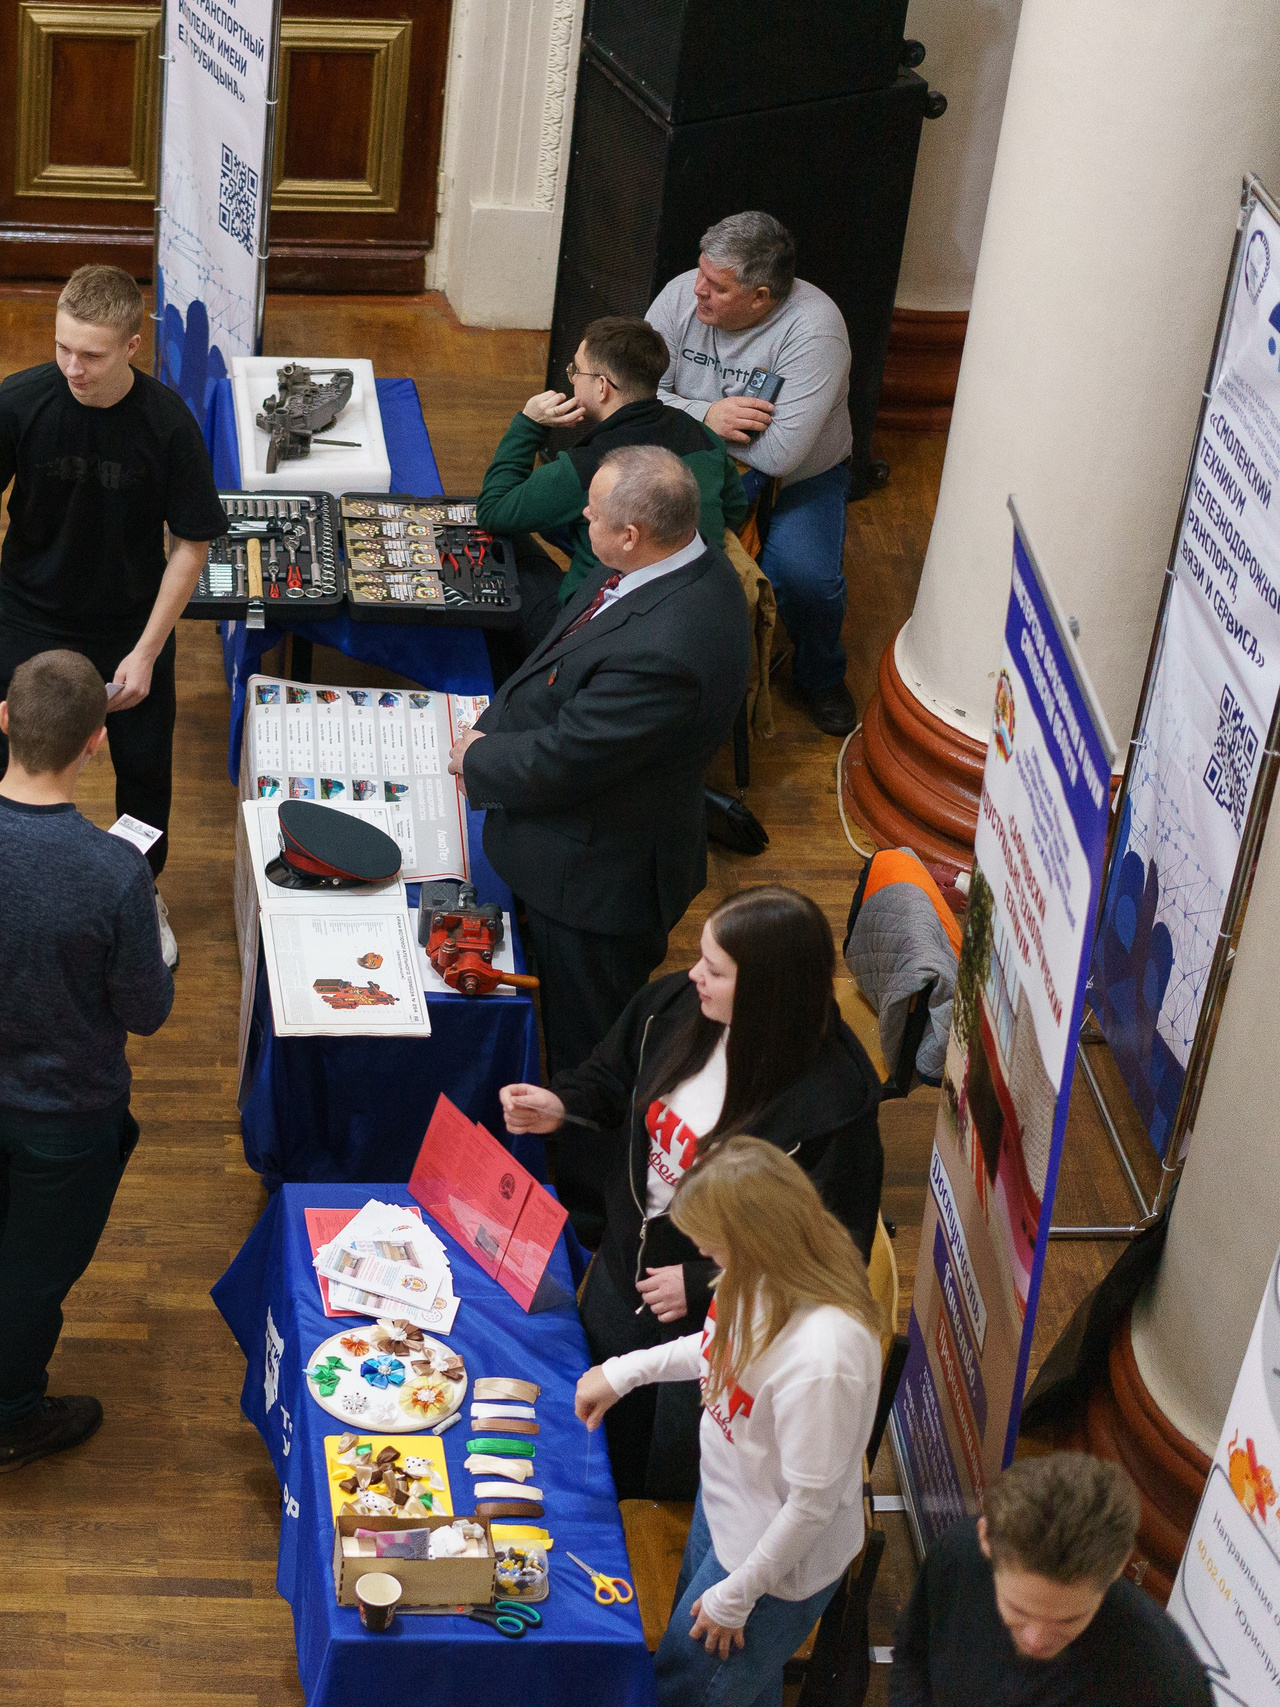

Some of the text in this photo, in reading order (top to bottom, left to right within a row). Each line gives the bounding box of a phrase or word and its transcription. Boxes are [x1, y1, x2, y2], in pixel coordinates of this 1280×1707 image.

[217, 36, 248, 77] ИМЕНИ
[1200, 436, 1246, 516] ТЕХНИКУМ
[1209, 412, 1272, 510] «СМОЛЕНСКИЙ
[1181, 538, 1266, 669] ВЯЗИ И СЕРВИСА»
[1186, 508, 1238, 603] РАНСПОРТА,
[1212, 1510, 1273, 1614] Направление
[1197, 1539, 1280, 1686] 40.02.04 "Юриспру
